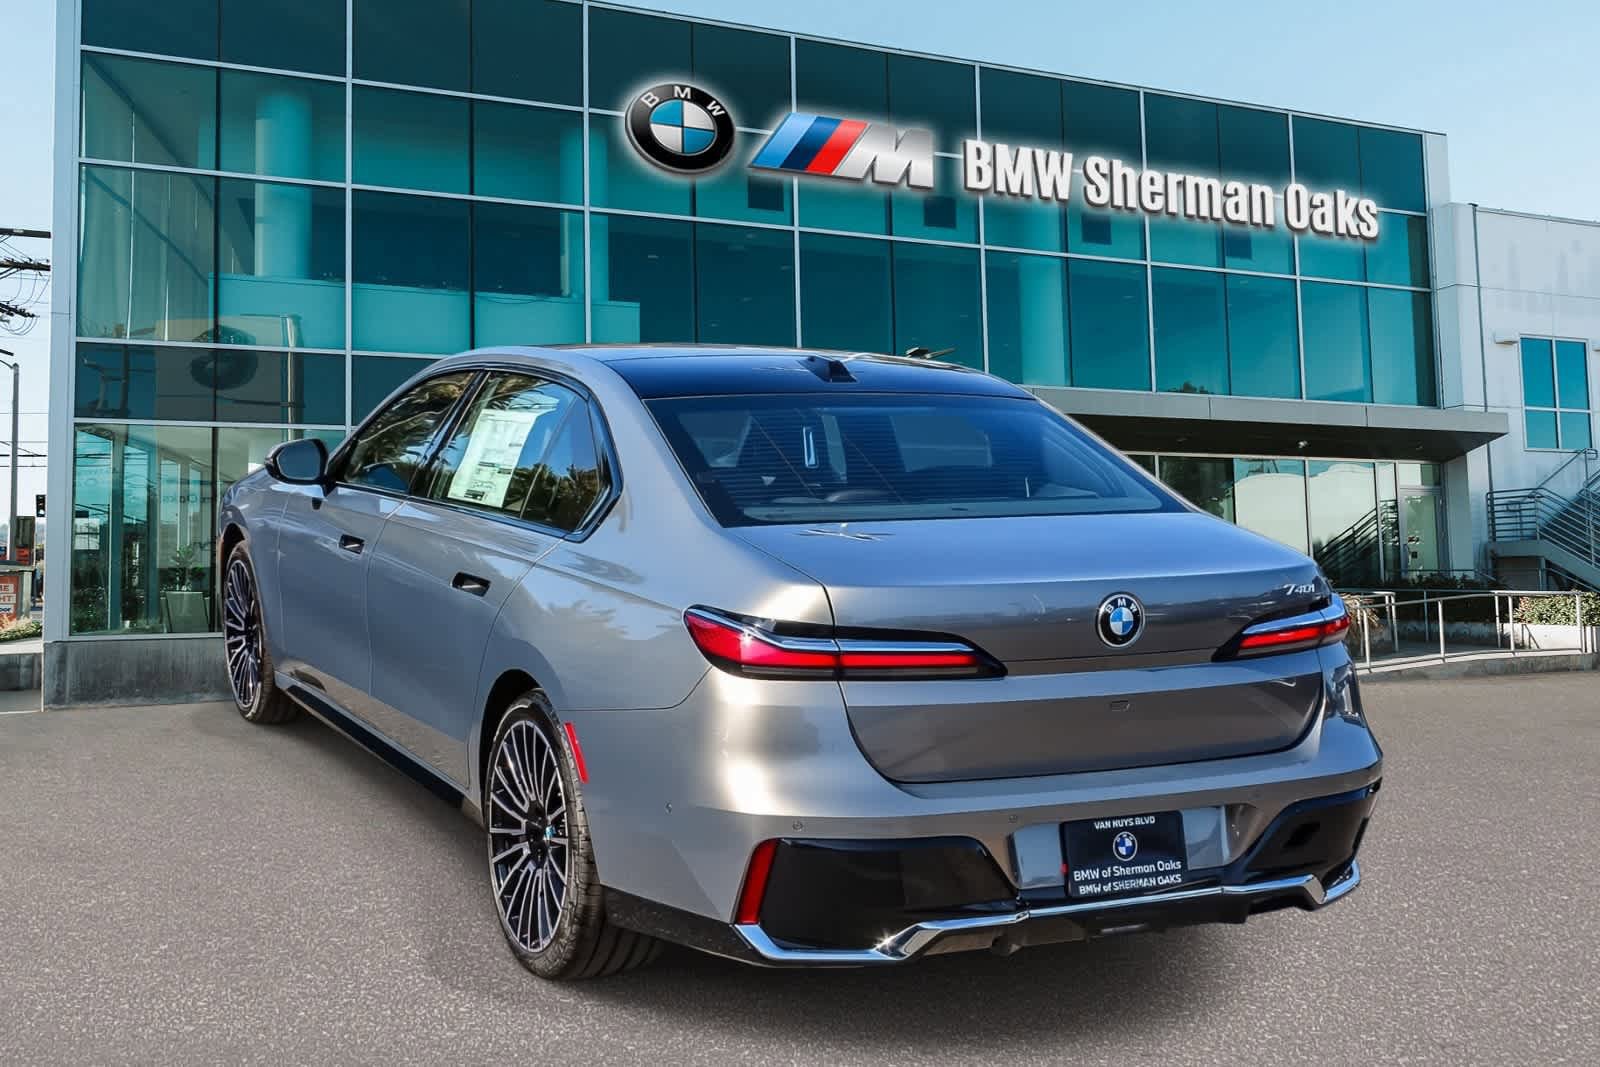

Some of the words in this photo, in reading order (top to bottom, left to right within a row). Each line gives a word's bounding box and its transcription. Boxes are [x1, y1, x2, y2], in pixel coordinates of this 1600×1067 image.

[640, 85, 726, 117] BMW
[964, 139, 1073, 201] BMW
[1083, 155, 1275, 226] Sherman
[1284, 183, 1379, 240] Oaks
[1105, 598, 1138, 614] BMW
[1094, 819, 1111, 830] VAN
[1112, 817, 1134, 828] NUYS
[1135, 815, 1156, 826] BLVD
[1073, 868, 1099, 882] BMW
[1102, 866, 1112, 878] of
[1113, 863, 1156, 877] Sherman
[1157, 860, 1182, 873] Oaks
[1079, 882, 1101, 895] BMW
[1102, 881, 1112, 892] of
[1113, 877, 1156, 891] SHERMAN
[1157, 873, 1182, 886] OAKS
